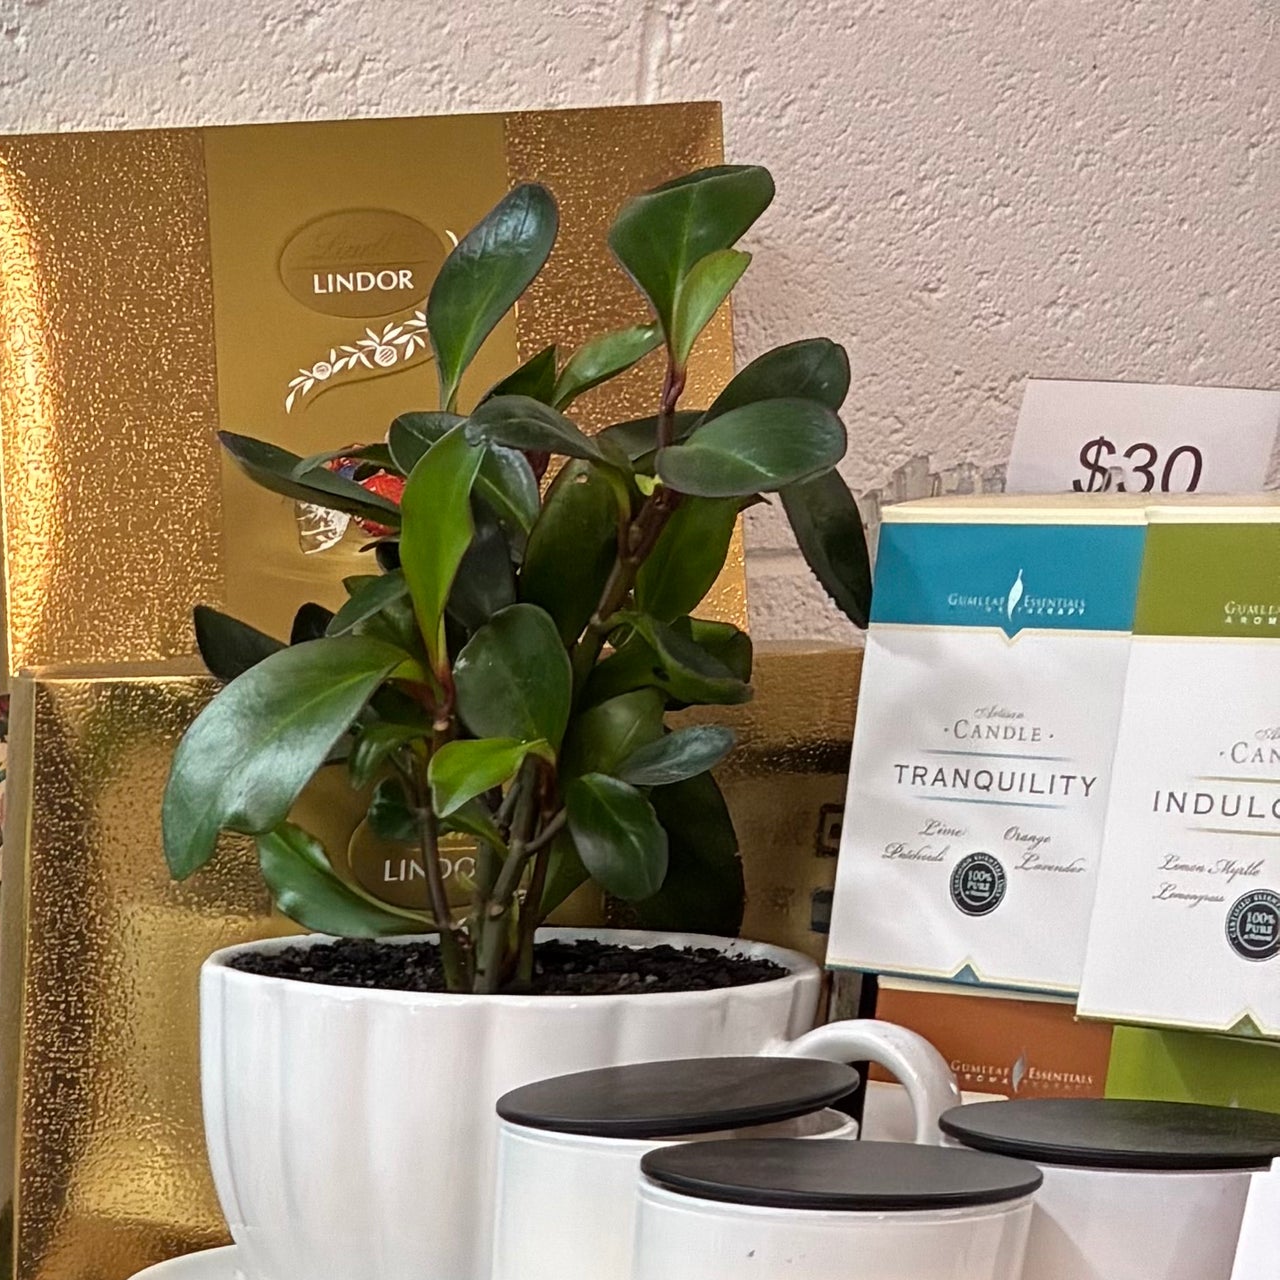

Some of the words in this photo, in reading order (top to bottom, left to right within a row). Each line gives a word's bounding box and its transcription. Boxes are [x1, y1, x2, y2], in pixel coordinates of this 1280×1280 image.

[313, 269, 414, 294] LINDOR
[1073, 436, 1204, 493] $30
[1224, 616, 1280, 625] AROM
[953, 719, 1042, 742] CANDLE
[1231, 741, 1280, 765] CAN
[894, 764, 1098, 797] TRANQUILITY
[384, 857, 476, 882] LINDO
[1028, 1067, 1095, 1085] ESSENTIALS
